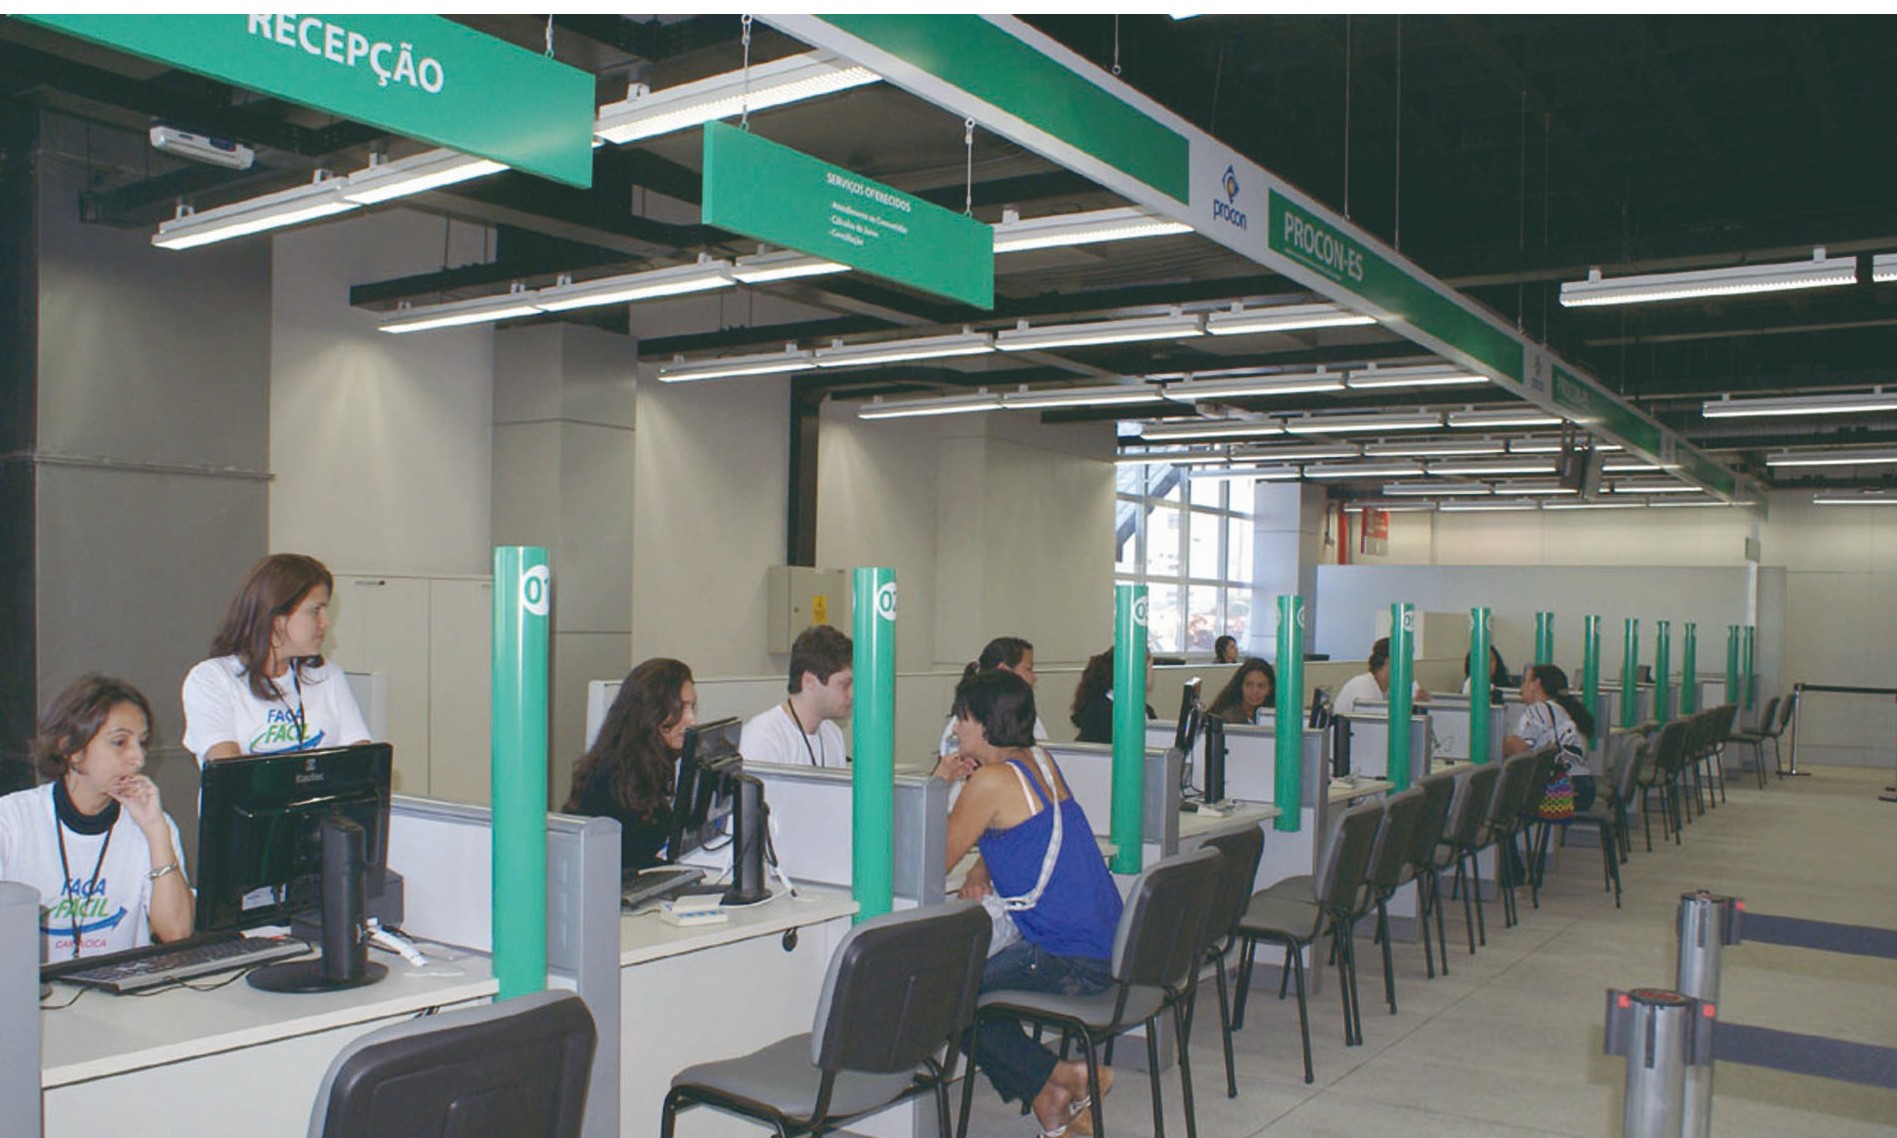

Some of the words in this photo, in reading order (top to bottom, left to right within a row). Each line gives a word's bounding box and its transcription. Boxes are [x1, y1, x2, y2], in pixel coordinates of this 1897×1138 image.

[247, 14, 445, 94] RECEPÇÃO
[826, 171, 864, 196] SERVIÇOS
[864, 186, 911, 213] OFERECIDOS
[1213, 199, 1248, 231] procon
[1283, 211, 1364, 282] PROCON-ES
